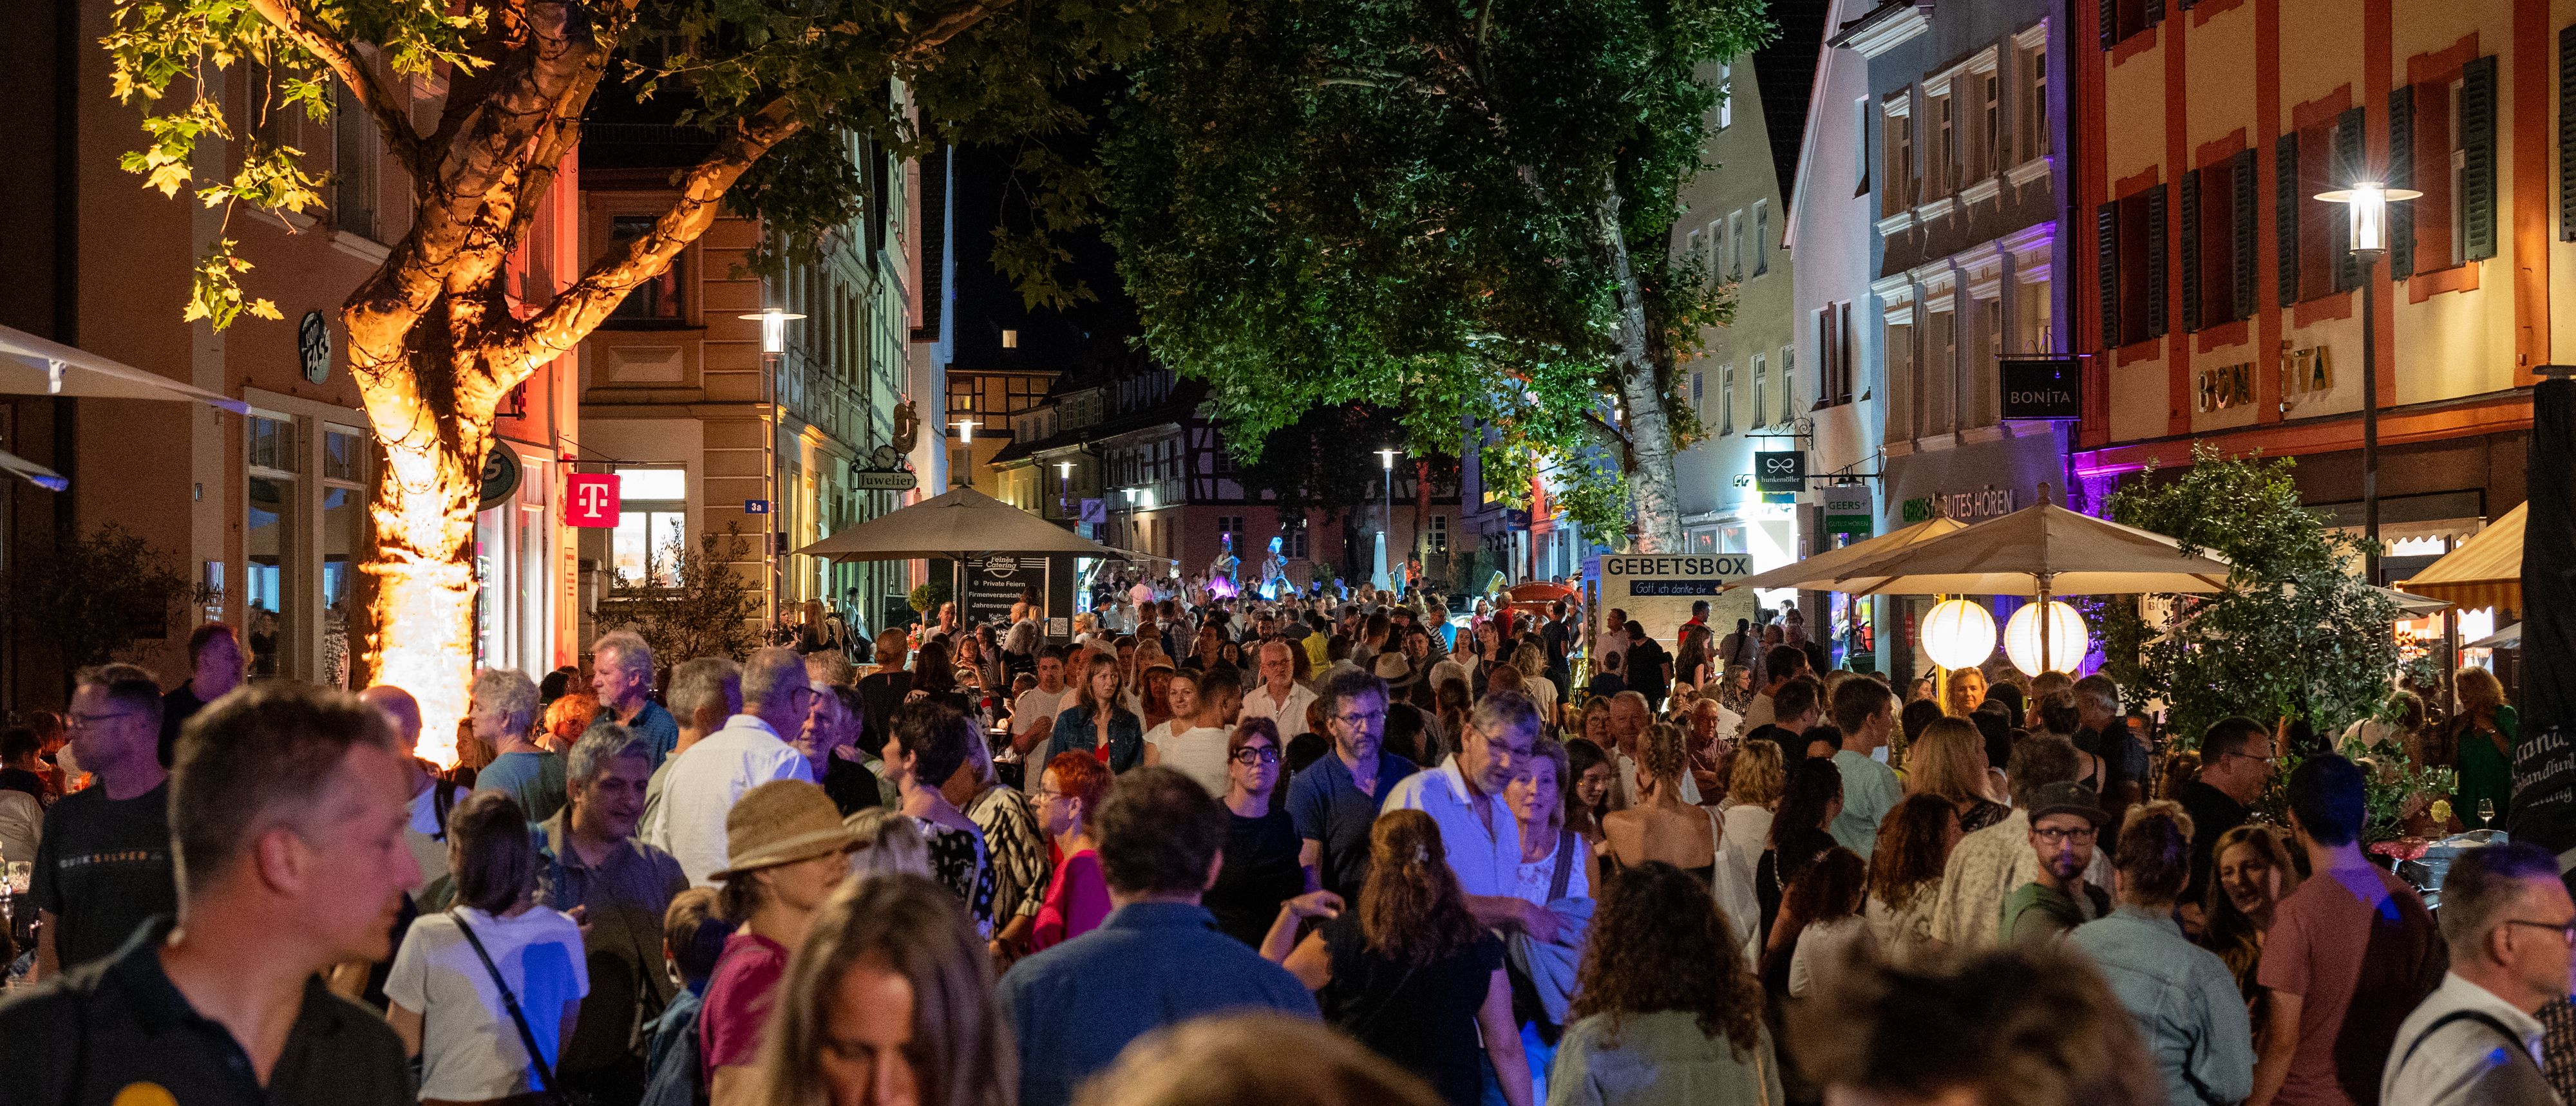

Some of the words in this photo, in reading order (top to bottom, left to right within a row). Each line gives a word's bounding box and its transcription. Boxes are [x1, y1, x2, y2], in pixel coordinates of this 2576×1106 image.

[307, 329, 331, 381] FASS
[861, 475, 912, 485] Juwelier
[579, 483, 608, 518] T
[1828, 501, 1861, 510] GEERS
[1975, 485, 2013, 516] HÖREN
[751, 502, 762, 512] 3a
[986, 561, 1017, 570] Catering
[1607, 558, 1748, 575] GEBETSBOX
[1636, 582, 1656, 594] Gott,
[1658, 583, 1669, 594] ich
[1672, 583, 1694, 594] danke
